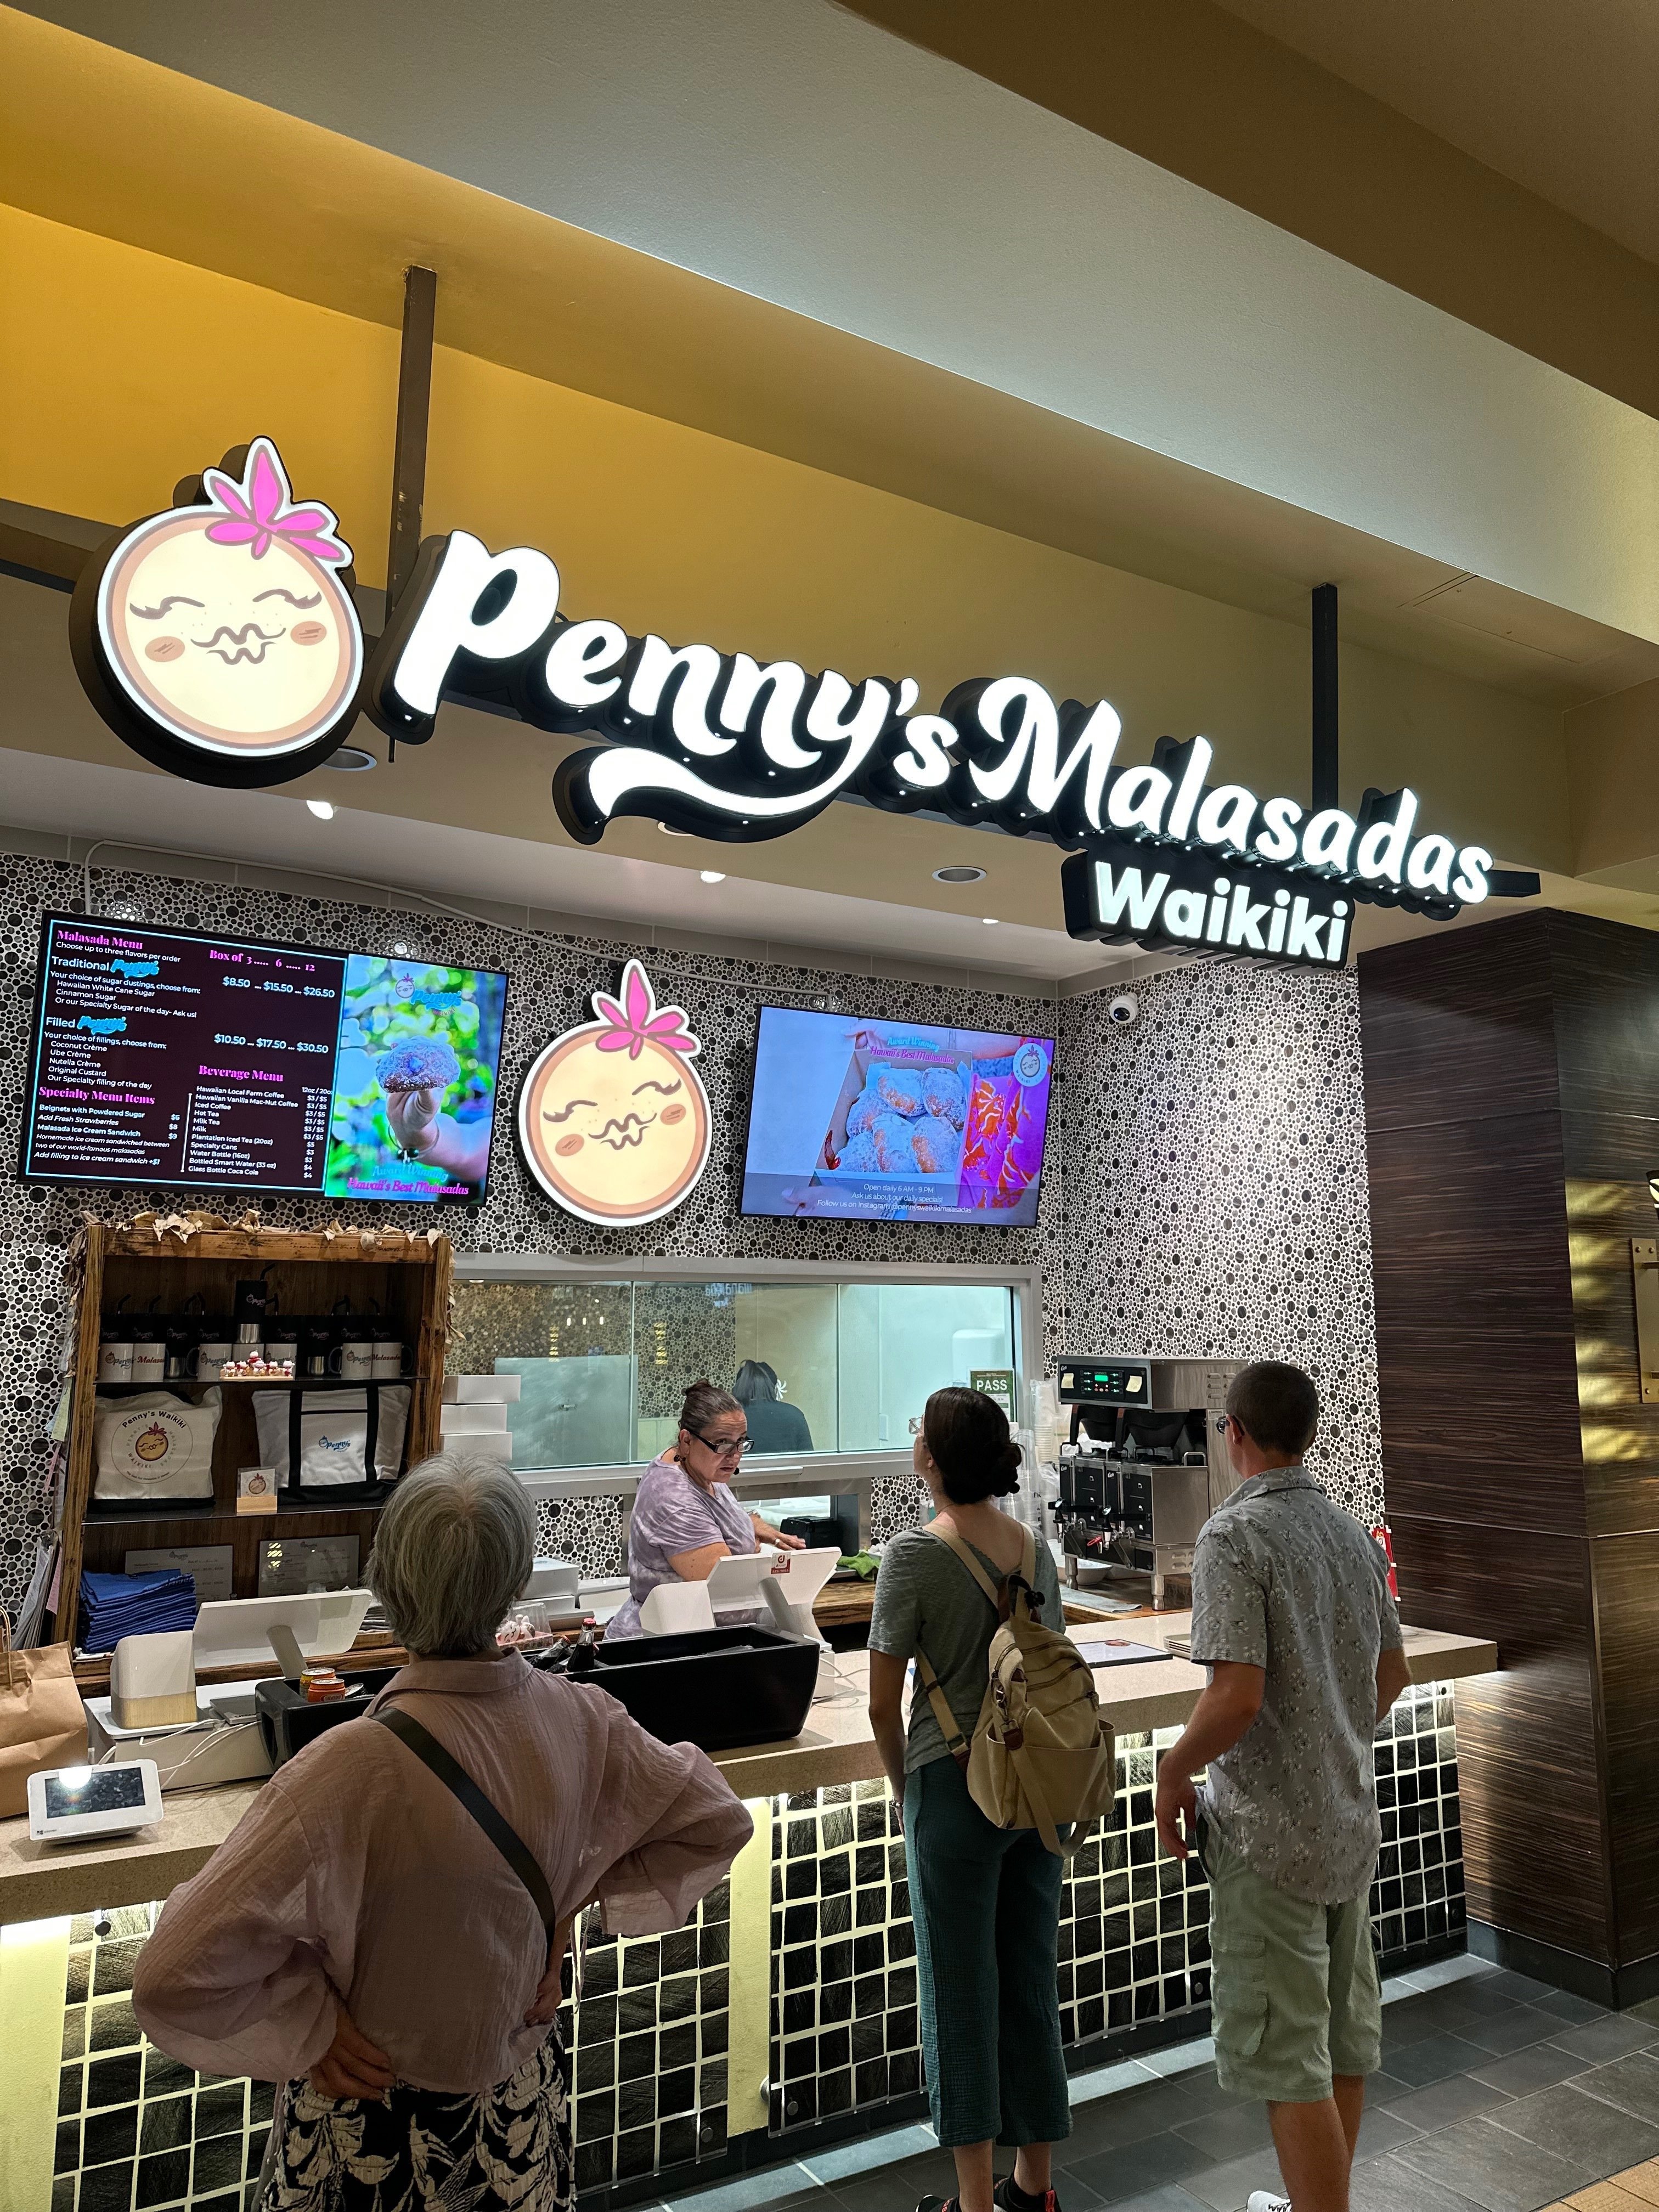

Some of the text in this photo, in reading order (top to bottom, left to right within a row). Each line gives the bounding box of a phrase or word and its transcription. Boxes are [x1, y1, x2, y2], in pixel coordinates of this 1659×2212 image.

[394, 529, 1493, 904] Penny's Malasadas
[1095, 861, 1348, 962] Waikiki
[57, 930, 143, 949] Malasada Menu
[56, 941, 83, 950] Choose
[125, 950, 148, 958] flavors
[52, 956, 109, 970] Traditional
[210, 950, 229, 960] Box
[231, 953, 244, 962] of
[246, 956, 253, 964] 3
[275, 958, 281, 967] 6
[57, 980, 90, 989] Hawaiian
[134, 989, 155, 997] Sugar
[69, 973, 92, 981] choice
[123, 979, 155, 989] dustings,
[156, 983, 181, 991] choose
[222, 976, 335, 997] $8.50 $15.50 $26.50
[55, 989, 116, 1001] Cinnamon Sugar
[79, 1000, 112, 1009] Specialty
[112, 1003, 134, 1011] Sugar
[46, 1017, 75, 1028] Filled
[50, 1041, 81, 1049] Coconut
[96, 1036, 121, 1045] fillings,
[214, 1033, 329, 1053] $10.50 $17.50 $30.50
[887, 1037, 940, 1052] Award Winning
[901, 1049, 916, 1059] Best
[917, 1051, 955, 1064] Malasadas
[78, 1068, 106, 1076] Custard
[199, 1065, 283, 1081] Beverage Menu
[63, 1075, 95, 1085] Specialty
[97, 1078, 116, 1087] filling
[38, 1086, 155, 1104] Specialty Menu Items
[39, 1104, 70, 1112] Beignets
[88, 1108, 123, 1116] Powdered
[75, 1116, 119, 1125] Strawberries
[37, 1124, 70, 1132] Malasada
[107, 1128, 140, 1137] Sandwich
[50, 1152, 70, 1160] filling
[373, 1163, 449, 1182] Award Winning
[392, 1180, 413, 1192] Best
[414, 1180, 469, 1195] Malasadas
[883, 1184, 896, 1193] daily
[858, 1201, 890, 1211] Instagram
[904, 1195, 918, 1203] daily
[977, 1379, 1007, 1391] PASS
[122, 1410, 187, 1429] Penny's Waikiki
[128, 1452, 151, 1468] WAIKIKI
